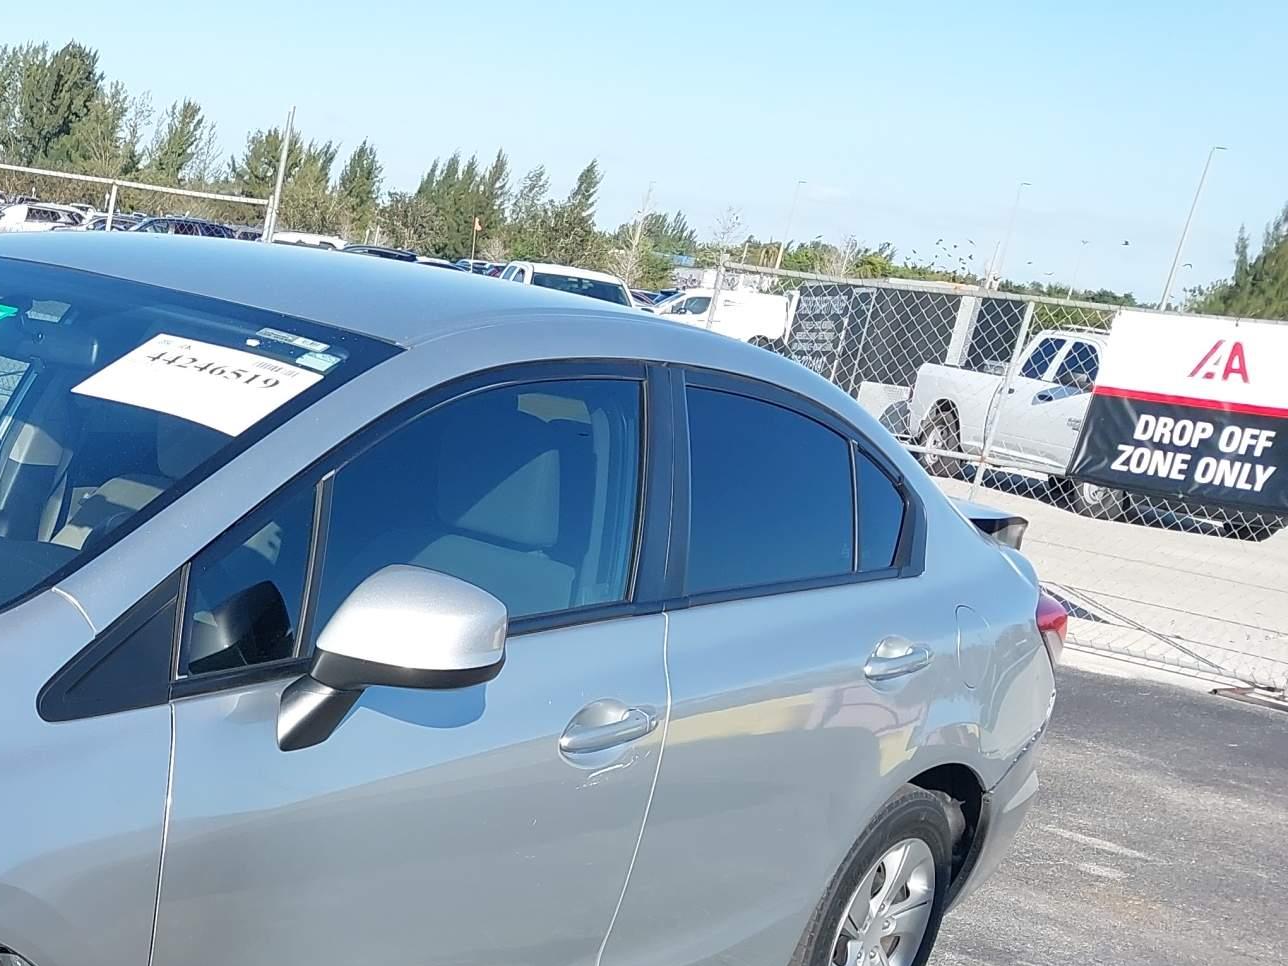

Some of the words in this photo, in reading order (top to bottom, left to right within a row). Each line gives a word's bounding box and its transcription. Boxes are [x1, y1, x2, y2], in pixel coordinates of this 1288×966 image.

[146, 351, 280, 389] 44246519
[1133, 414, 1214, 448] DROP
[1218, 425, 1276, 457] OFF
[1110, 444, 1192, 480] ZONE
[1193, 456, 1277, 492] ONLY
